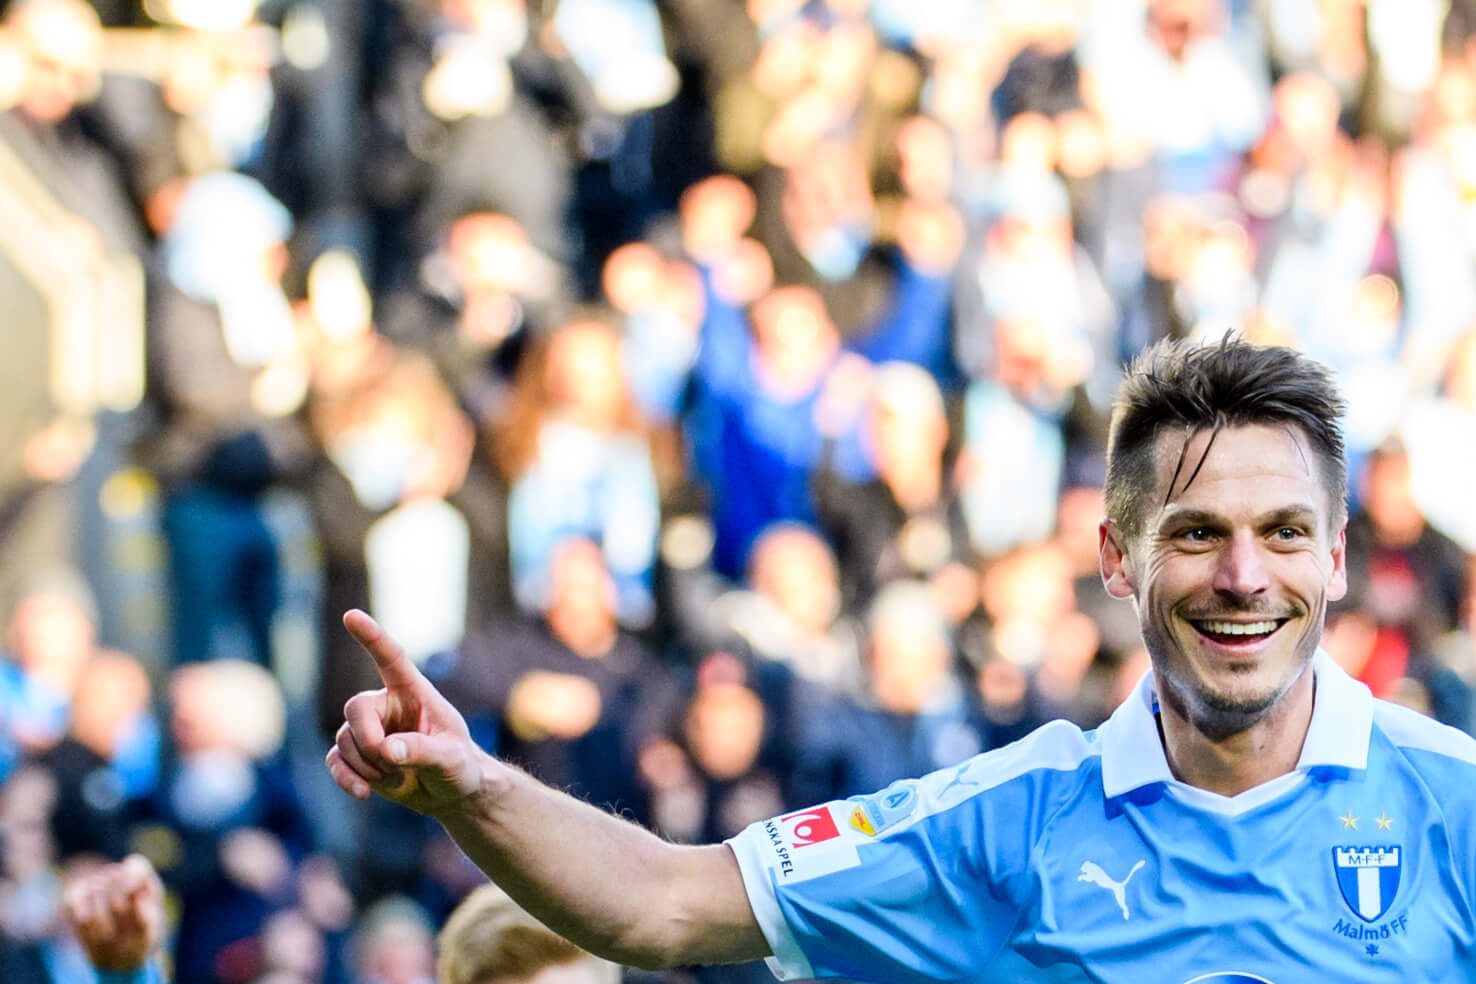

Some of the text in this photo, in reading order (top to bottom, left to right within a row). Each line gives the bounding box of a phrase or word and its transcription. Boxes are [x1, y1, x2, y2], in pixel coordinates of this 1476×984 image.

[764, 819, 795, 878] NSKA SPEL
[1332, 914, 1408, 940] Malmö FF
